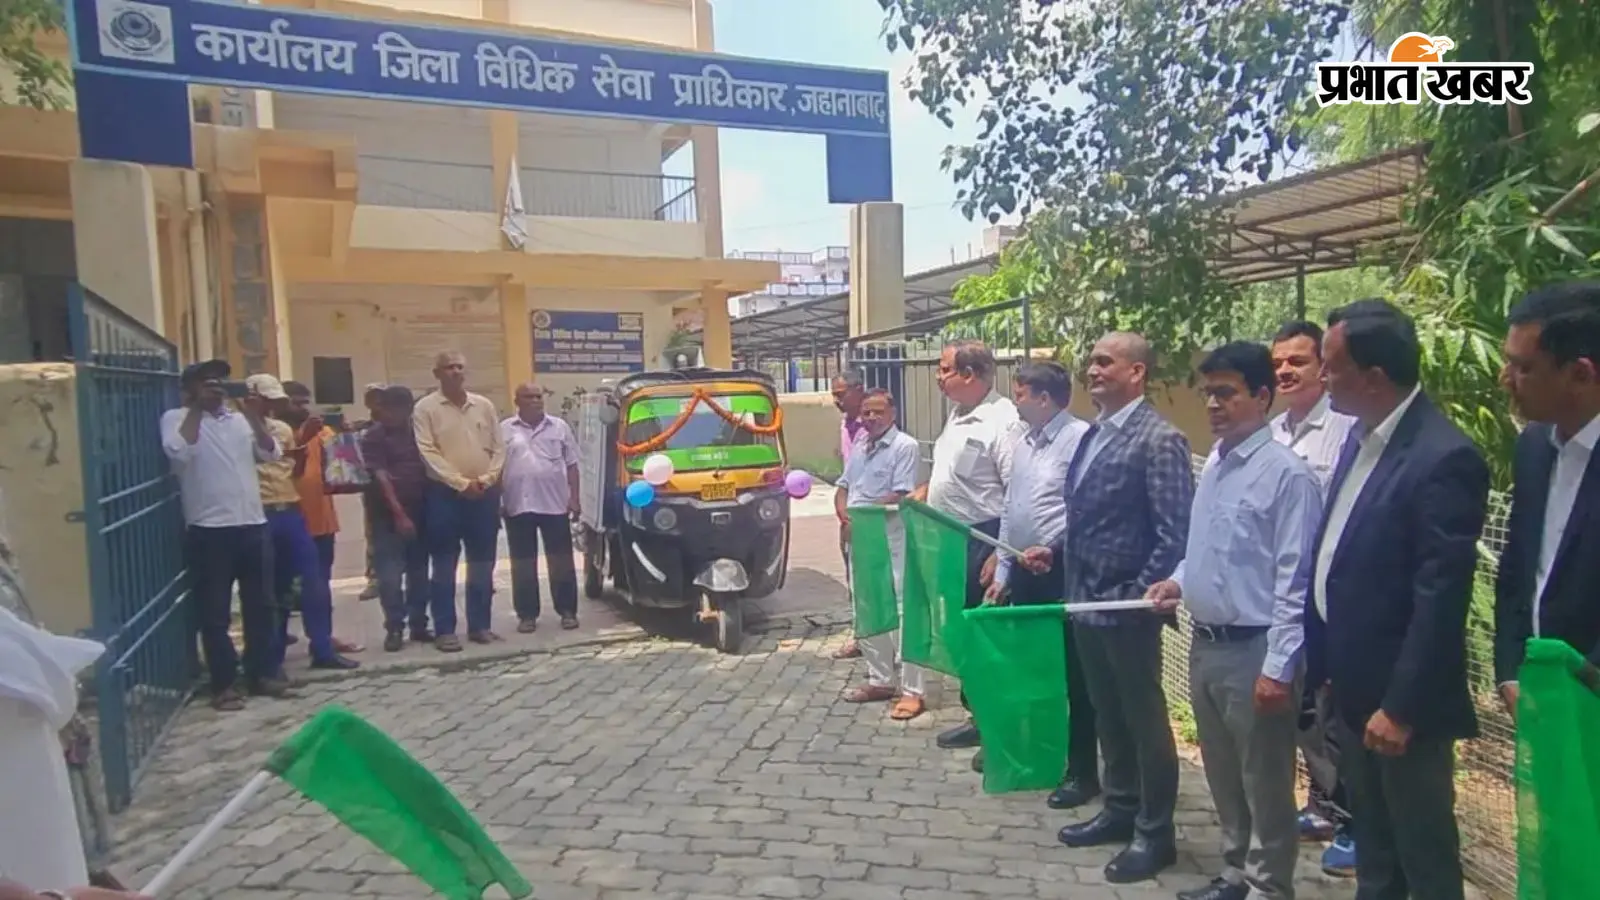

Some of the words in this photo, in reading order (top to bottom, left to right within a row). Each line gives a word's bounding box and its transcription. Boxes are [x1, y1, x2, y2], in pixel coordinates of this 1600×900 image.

[191, 19, 357, 75] कार्यालय
[373, 31, 461, 85] जिला
[475, 42, 578, 94] विधिक
[592, 54, 655, 101] सेवा
